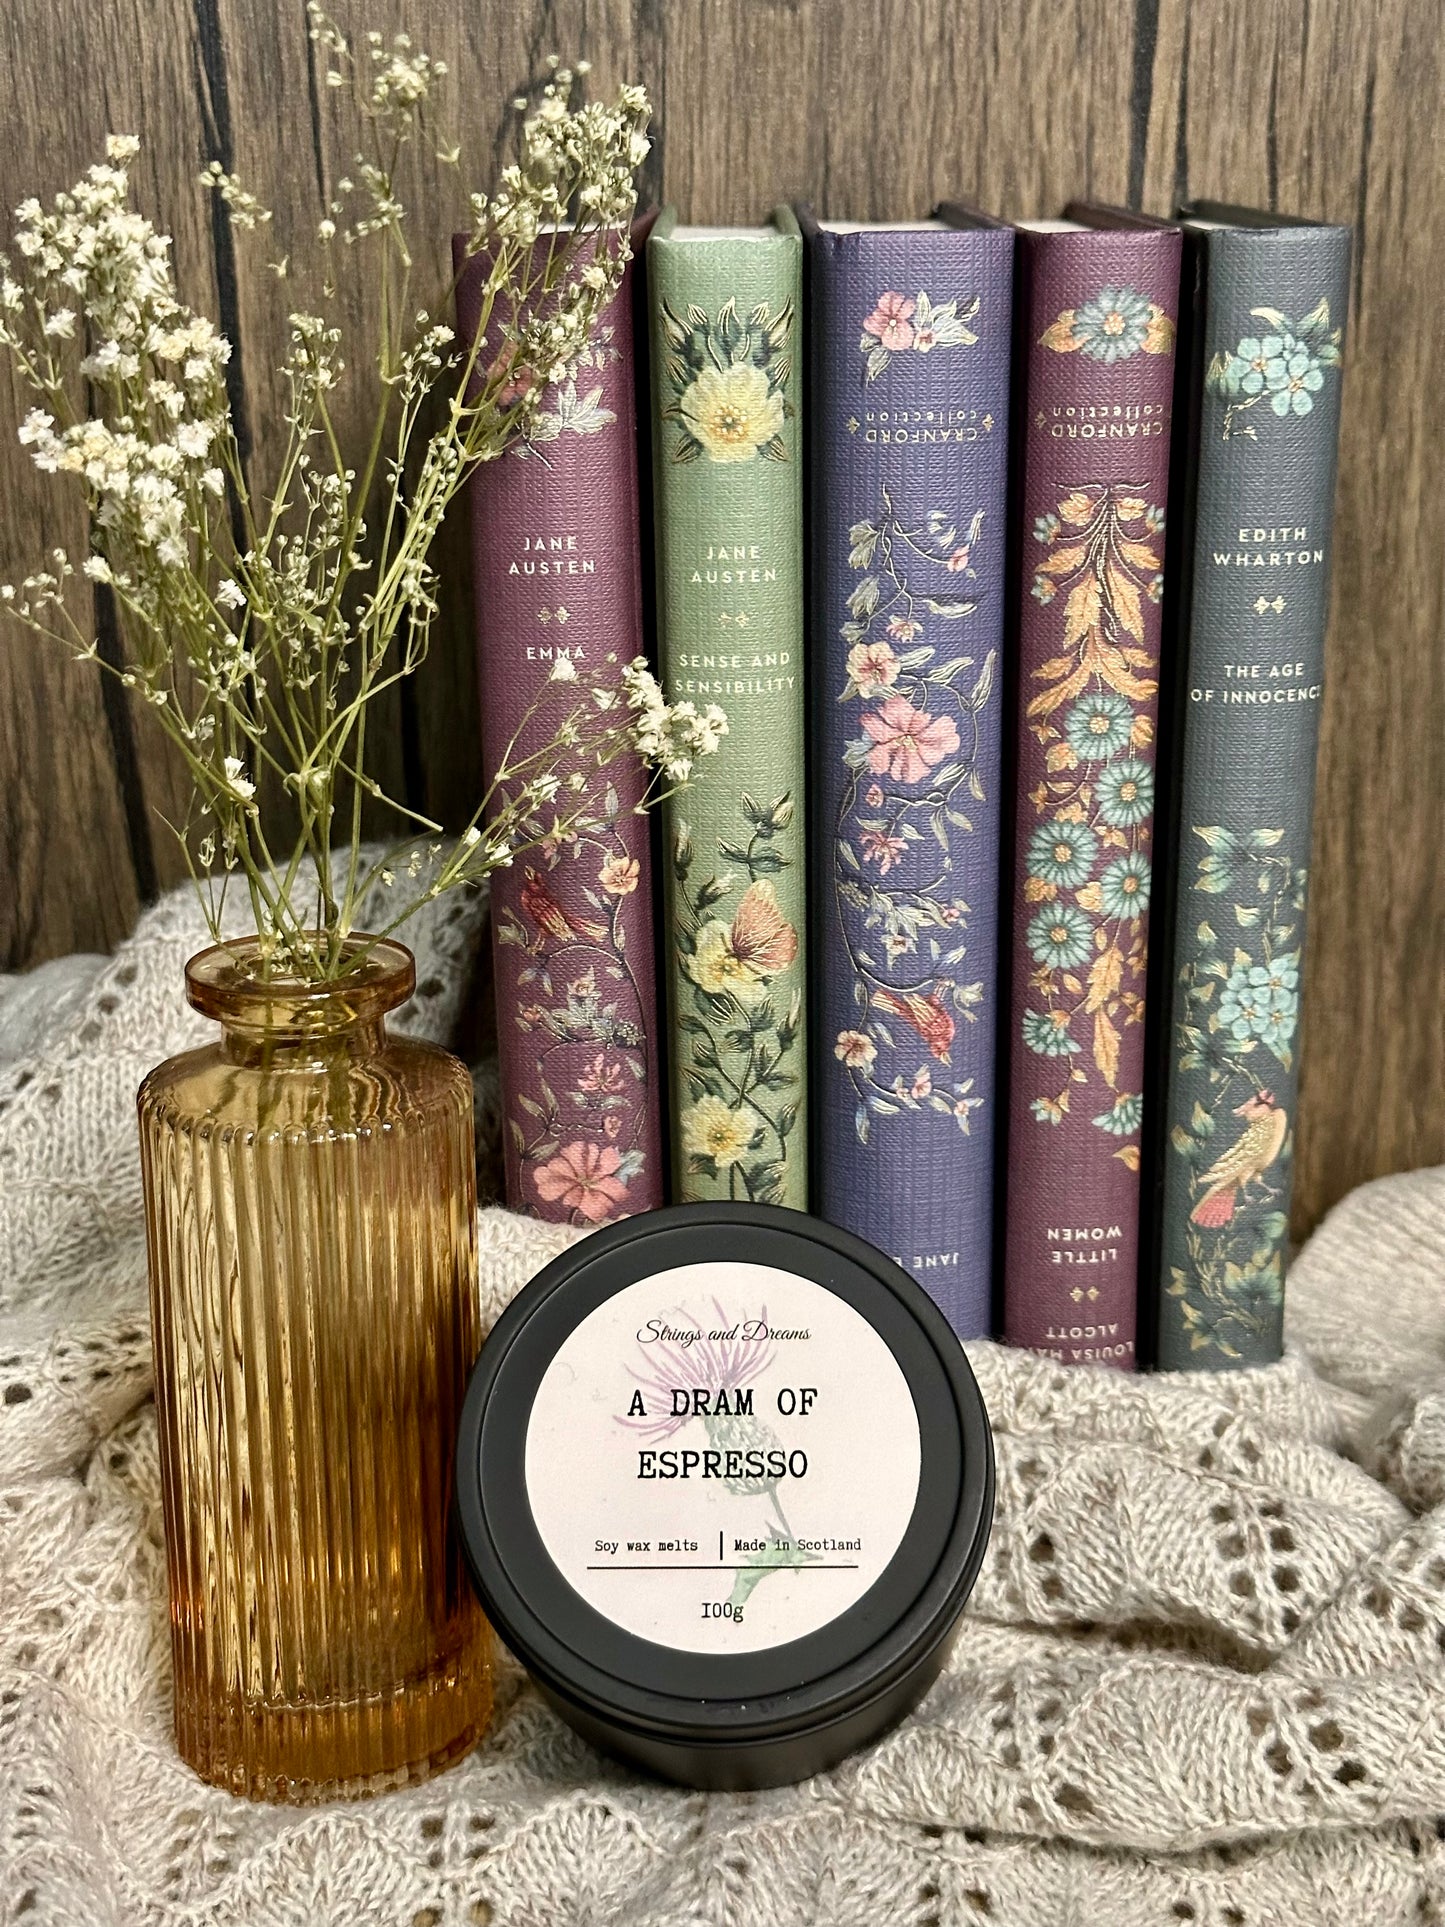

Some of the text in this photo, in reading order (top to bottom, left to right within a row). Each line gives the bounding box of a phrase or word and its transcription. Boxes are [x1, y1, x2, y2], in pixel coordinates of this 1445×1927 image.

[866, 409, 977, 425] collection
[1053, 404, 1163, 418] collection
[865, 427, 978, 443] CRANFORD
[1051, 422, 1163, 438] CRANFORD
[1238, 527, 1307, 542] EDITH
[524, 536, 578, 551] JANE
[706, 546, 761, 560] JANE
[1213, 550, 1323, 566] WHARTON
[508, 560, 596, 575] AUSTEN
[691, 569, 777, 584] AUSTEN
[526, 646, 586, 660] EMMA
[679, 652, 791, 669] SENSE AND
[1224, 663, 1305, 678] THE AGE
[675, 677, 796, 693] SENSIBILITY
[1190, 689, 1214, 702] OF
[1047, 1225, 1122, 1241] WOMEN
[913, 1252, 960, 1270] JANE
[1052, 1248, 1118, 1264] LITTLE
[636, 1319, 812, 1348] Strings and Dreams
[1045, 1322, 1119, 1340] ALCOTT
[1072, 1341, 1134, 1360] LOUISA
[627, 1387, 818, 1417] A DRAM OF
[637, 1450, 808, 1479] ESPRESSO
[594, 1538, 699, 1554] Soy wax melts
[734, 1537, 862, 1551] Made in Scotland
